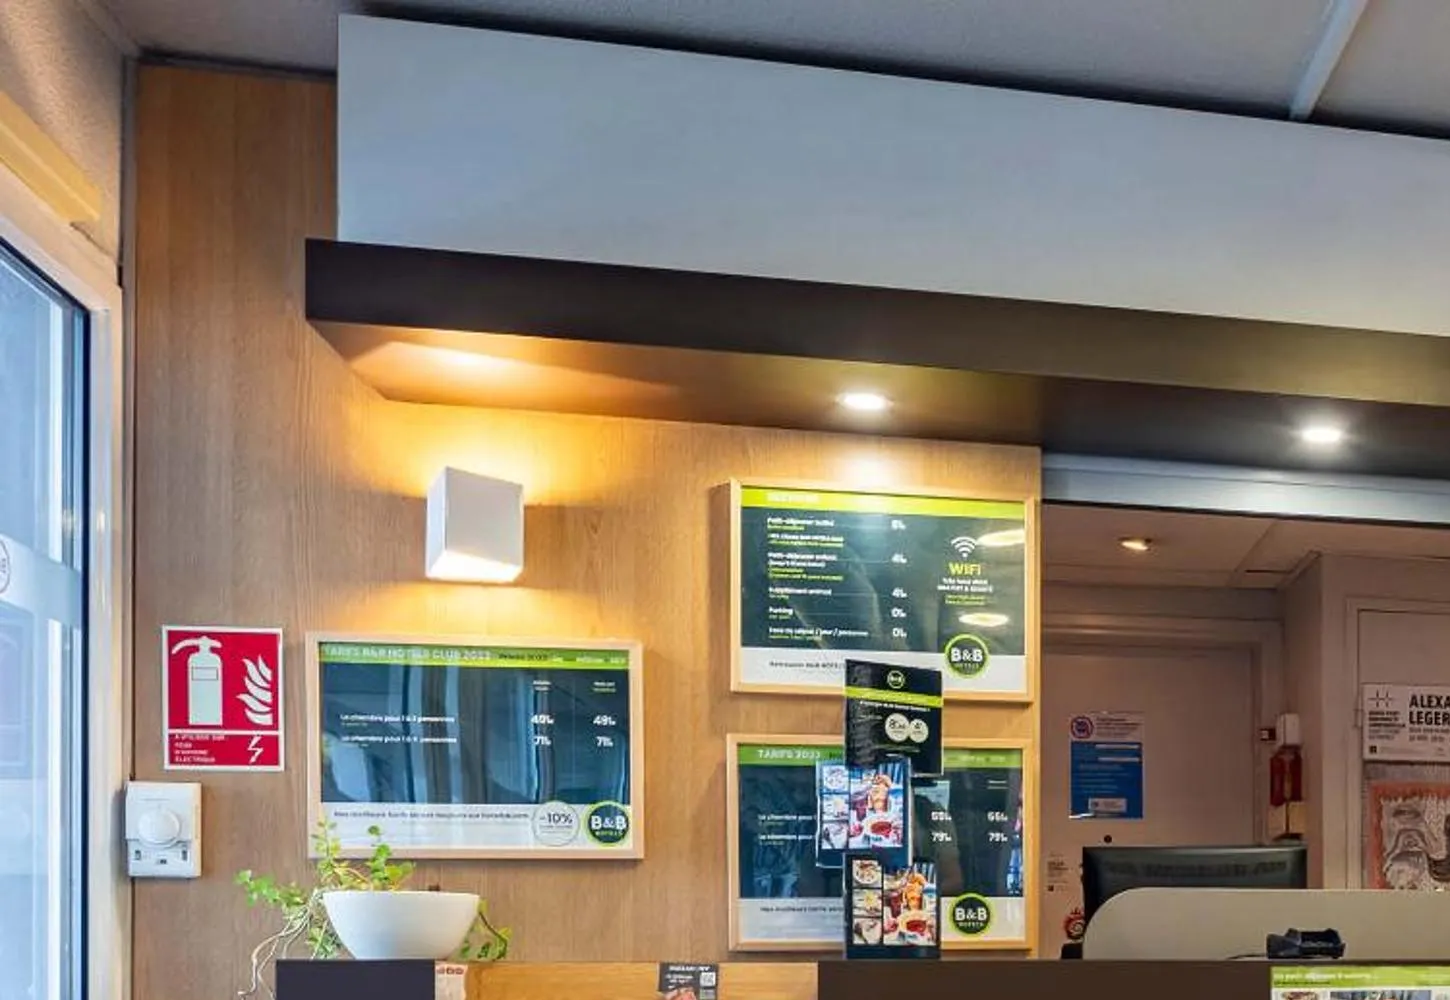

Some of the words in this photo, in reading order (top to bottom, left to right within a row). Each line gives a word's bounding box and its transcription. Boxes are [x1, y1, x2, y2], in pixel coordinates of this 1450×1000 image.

[950, 647, 983, 662] B&B
[1408, 711, 1450, 726] LEGER
[590, 815, 627, 830] B&B
[954, 907, 989, 922] B&B
